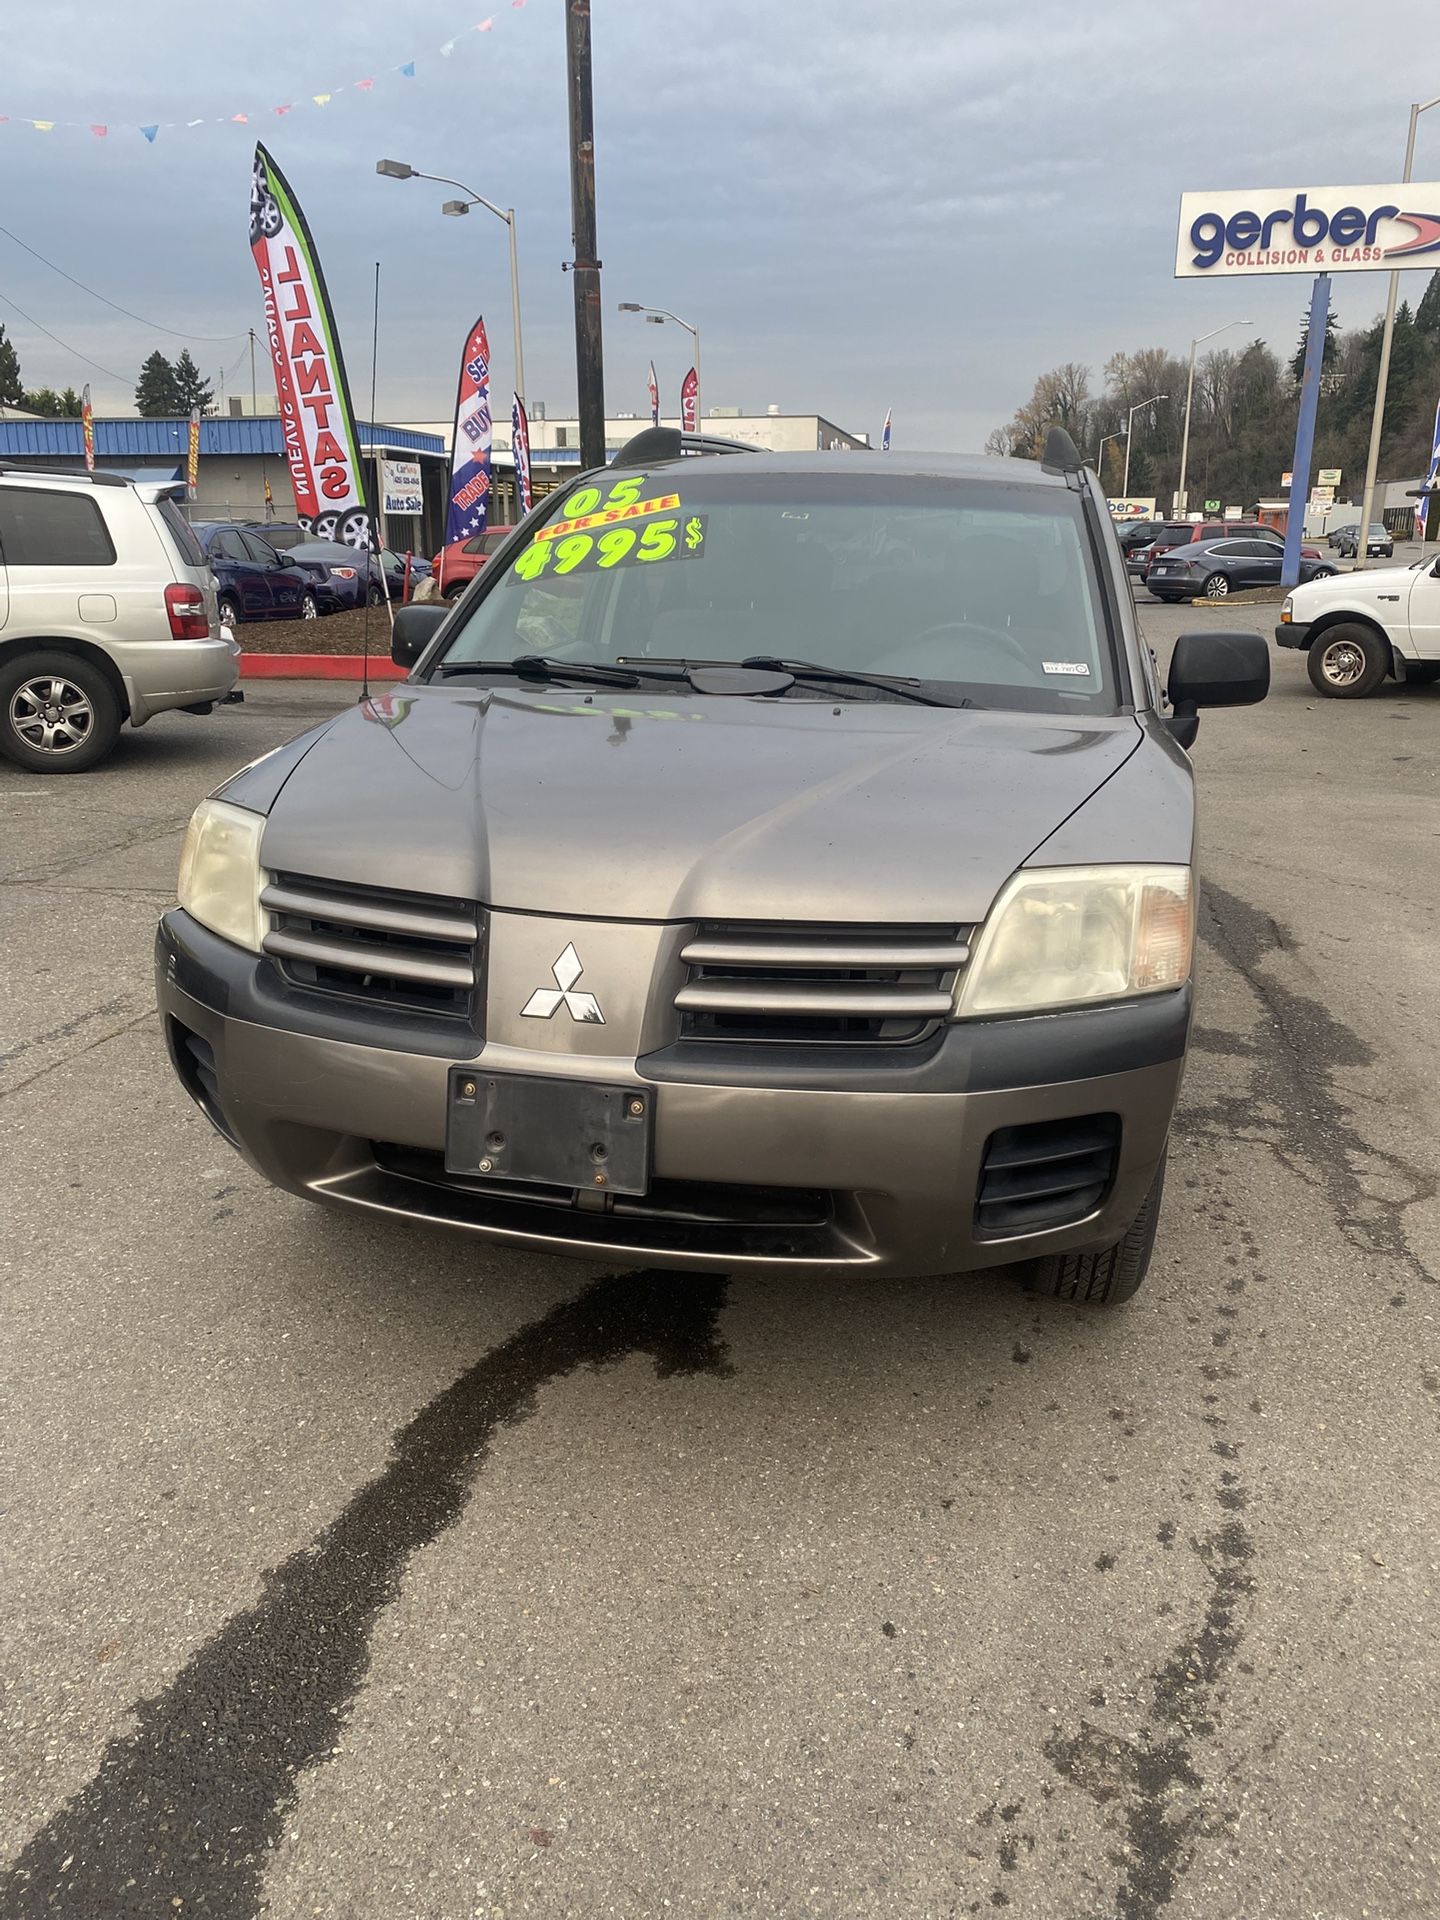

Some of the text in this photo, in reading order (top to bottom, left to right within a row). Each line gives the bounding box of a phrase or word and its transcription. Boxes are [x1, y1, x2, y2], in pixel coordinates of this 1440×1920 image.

[1190, 194, 1400, 268] gerber
[1226, 247, 1381, 266] COLLISION & GLASS
[462, 404, 491, 442] BUY
[386, 495, 421, 511] Auto Sale
[454, 470, 489, 511] TRADE
[563, 476, 645, 518] 05
[537, 495, 675, 542] FOR SALE
[514, 517, 704, 581] 4995 $
